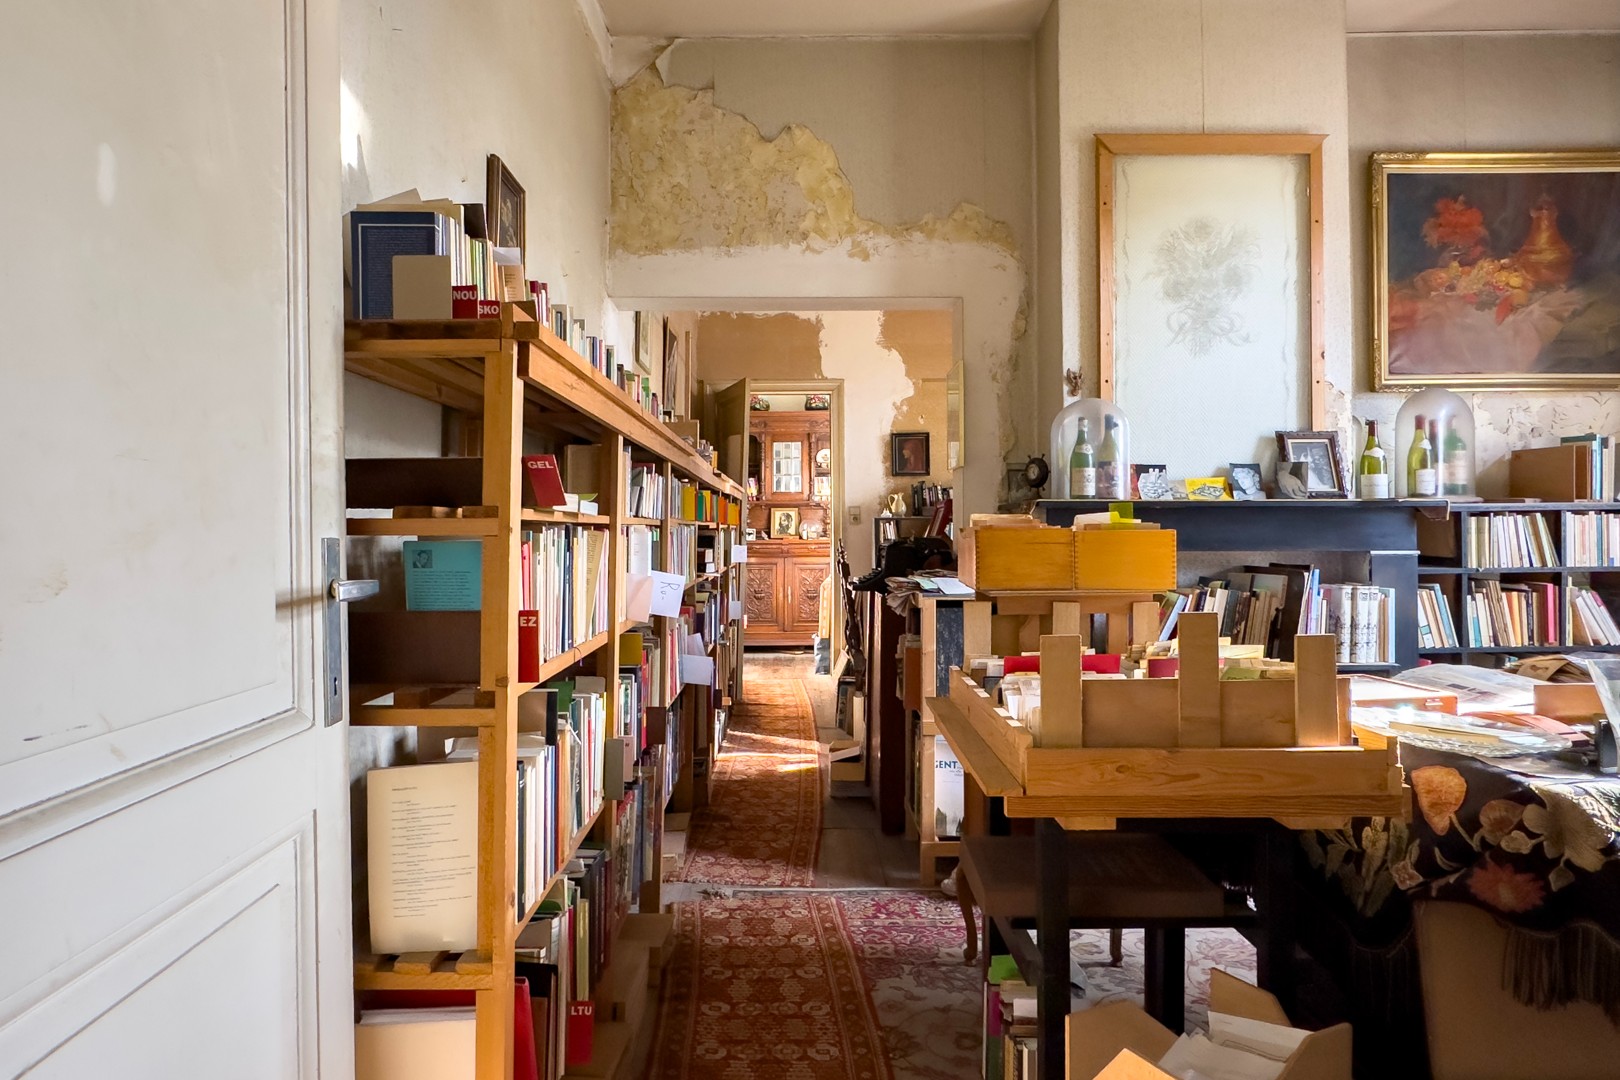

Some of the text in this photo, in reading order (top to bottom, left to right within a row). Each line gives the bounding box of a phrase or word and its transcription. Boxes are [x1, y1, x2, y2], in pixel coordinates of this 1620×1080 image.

[453, 290, 477, 300] NOU
[527, 461, 554, 469] GEL
[520, 616, 537, 627] EZ
[571, 1006, 592, 1016] LTU
